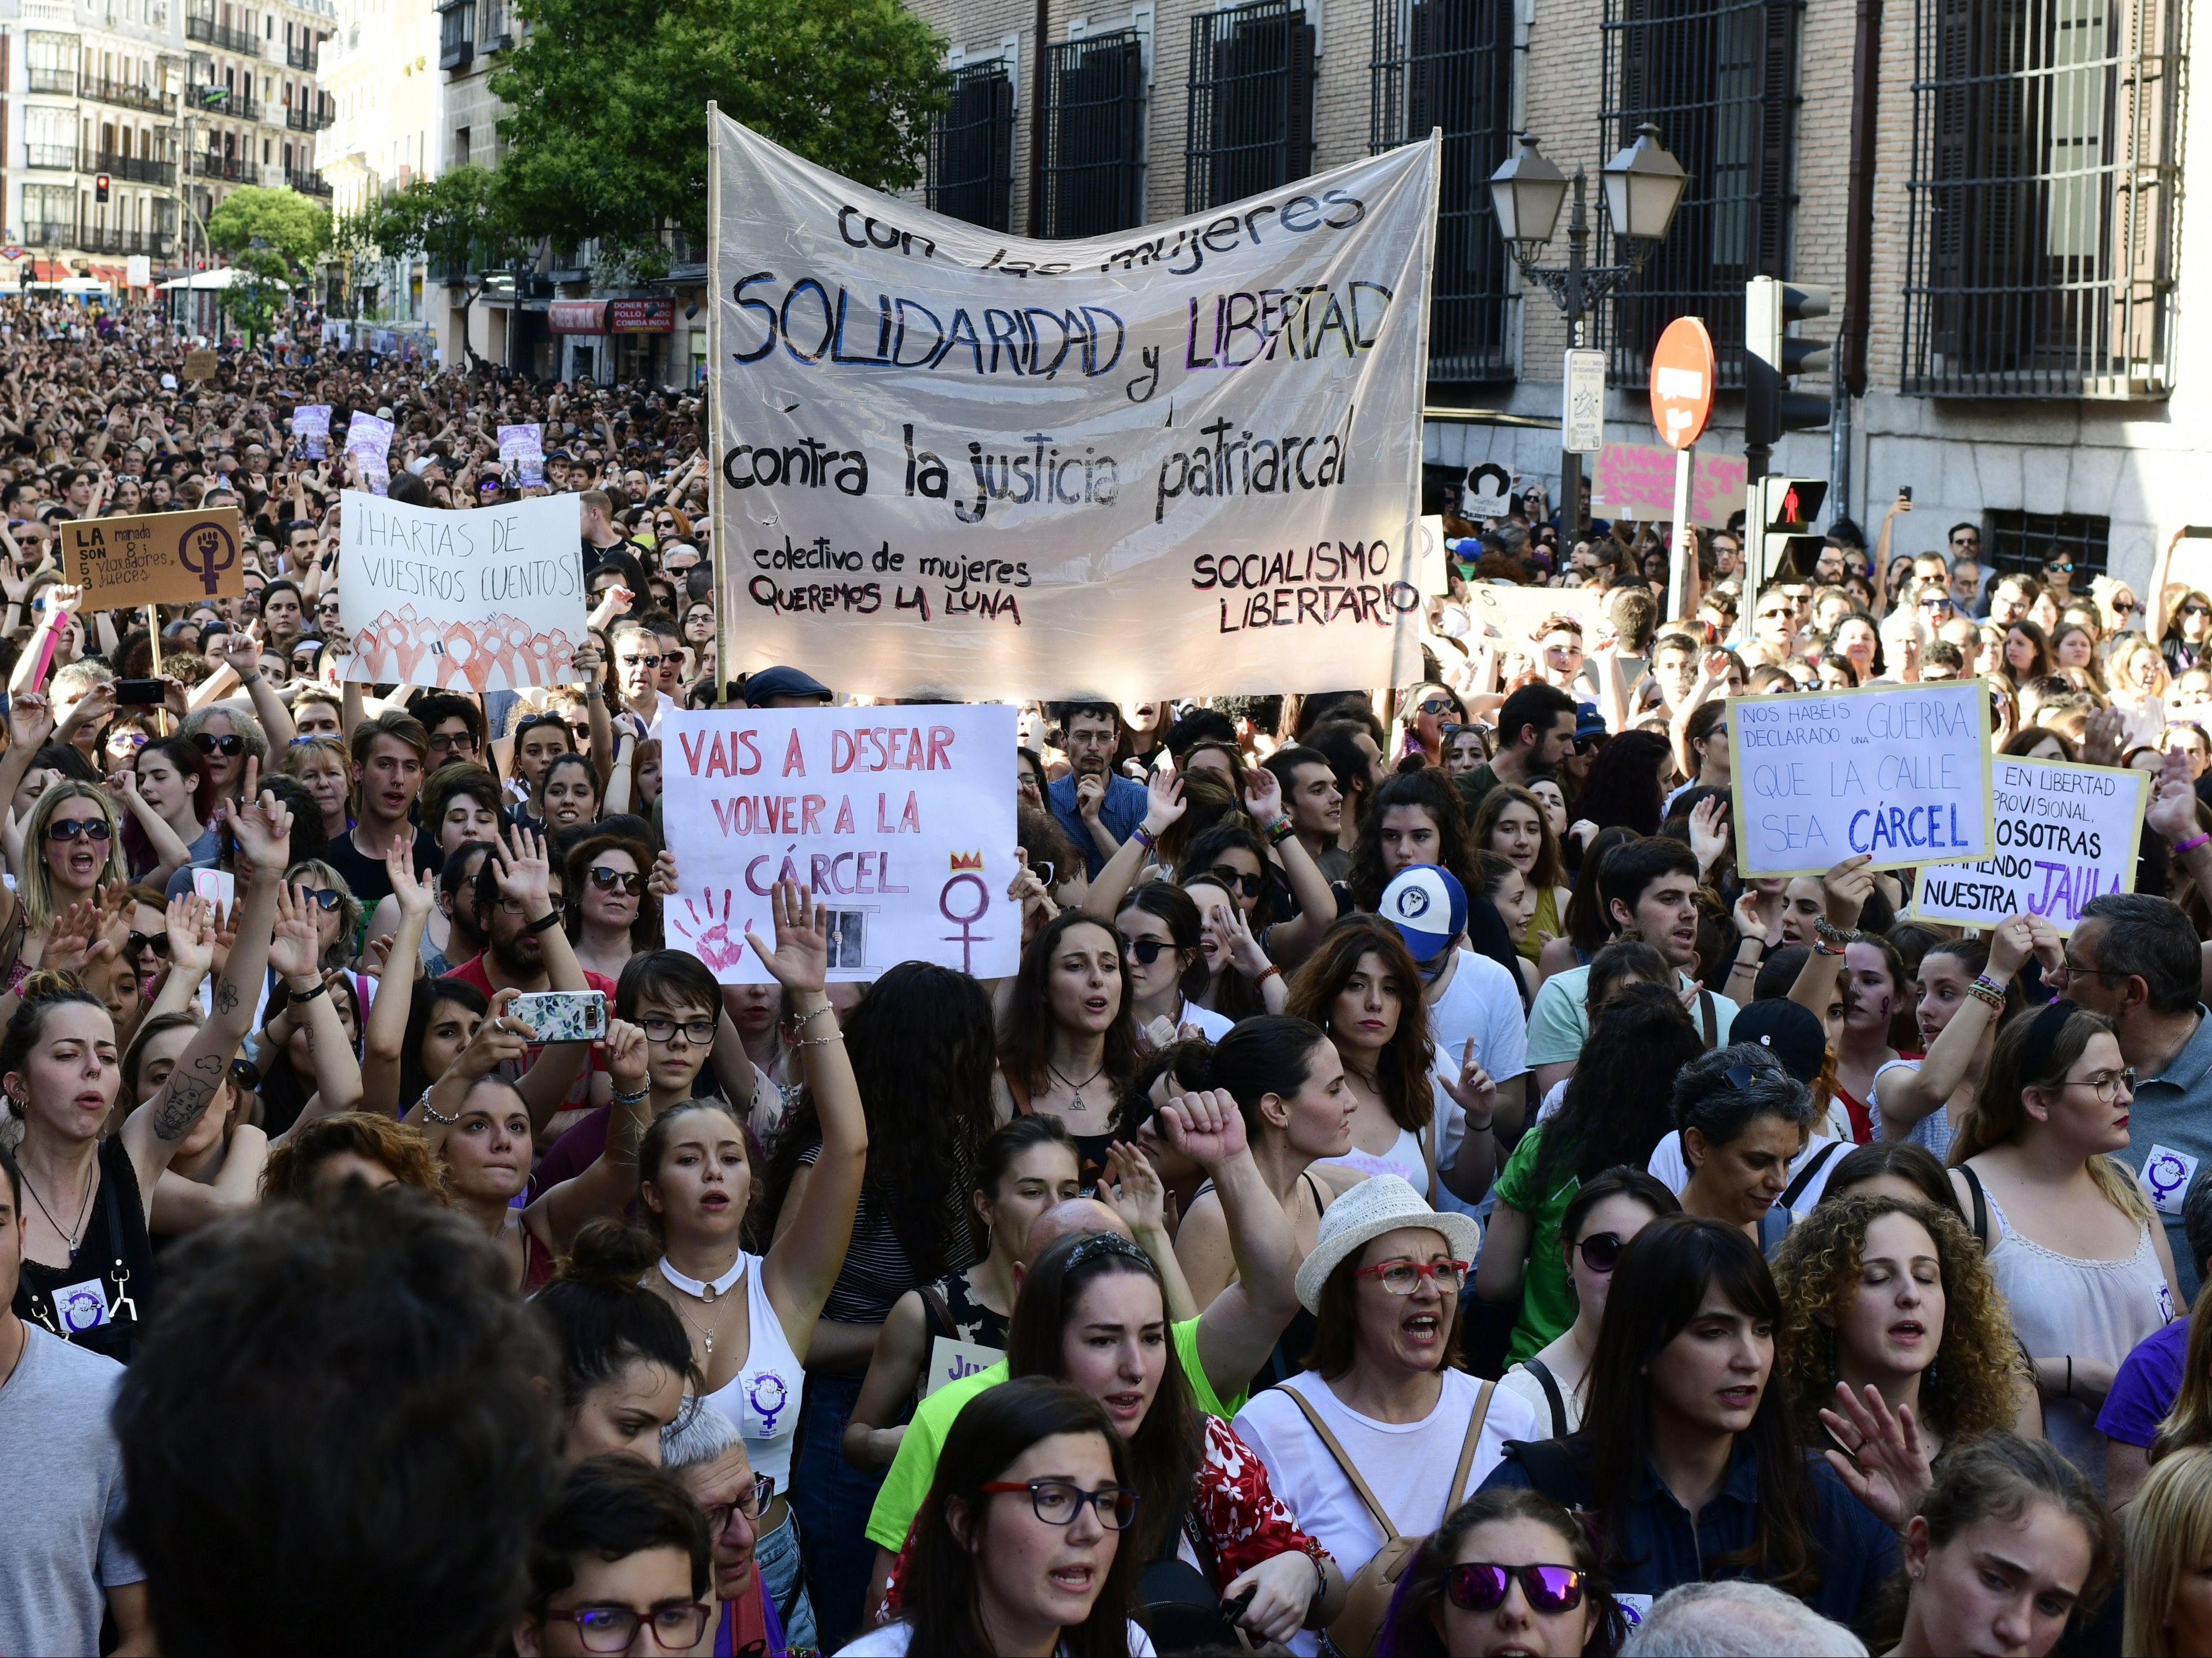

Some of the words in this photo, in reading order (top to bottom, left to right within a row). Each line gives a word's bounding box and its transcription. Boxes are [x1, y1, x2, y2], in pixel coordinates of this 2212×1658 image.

[838, 205, 936, 258] con
[1101, 190, 1366, 274] mujeres
[733, 272, 1125, 379] SOLIDARIDAD
[1126, 344, 1159, 403] y
[1185, 281, 1393, 370] LIBERTAD
[723, 437, 868, 497] contra
[903, 424, 948, 499] la
[955, 433, 1120, 523] justicia
[1155, 405, 1354, 524] patriarcal
[77, 527, 104, 547] LA
[114, 522, 151, 542] manada
[80, 547, 106, 560] SON
[356, 503, 474, 557] ¡HARTAS
[492, 516, 524, 554] DE
[80, 562, 90, 575] 5
[83, 577, 93, 590] 3
[362, 555, 465, 602] VUESTROS
[481, 552, 583, 602] CUENTOS!
[753, 535, 864, 573] colectivo
[872, 541, 903, 573] de
[919, 554, 1032, 592] mujeres
[1192, 540, 1389, 590] SOCIALISMO
[748, 575, 882, 615] QUEREMOS
[894, 585, 931, 623] LA
[945, 589, 1021, 627] LUNA
[1220, 581, 1420, 634] LIBERTARIO
[1743, 706, 1779, 723] NOS
[1745, 728, 1840, 748] DECLARADO
[1851, 736, 1869, 745] UNA
[1867, 700, 1976, 740] GUERRA.
[679, 730, 762, 778] VAIS
[782, 728, 806, 777] A
[831, 726, 954, 774] DESEAR
[1753, 763, 1812, 799] QUE
[1831, 760, 1865, 796] LA
[1878, 754, 1961, 791] CALLE
[2005, 766, 2032, 787] EN
[711, 794, 826, 837] VOLVER
[833, 795, 855, 834] A
[878, 790, 921, 833] LA
[1762, 814, 1828, 852] SEA
[1848, 801, 1969, 853] CÁRCEL
[1994, 818, 2102, 859] OSOTRAS
[745, 843, 909, 896] CÁRCEL
[1923, 879, 2018, 914] NUESTRA
